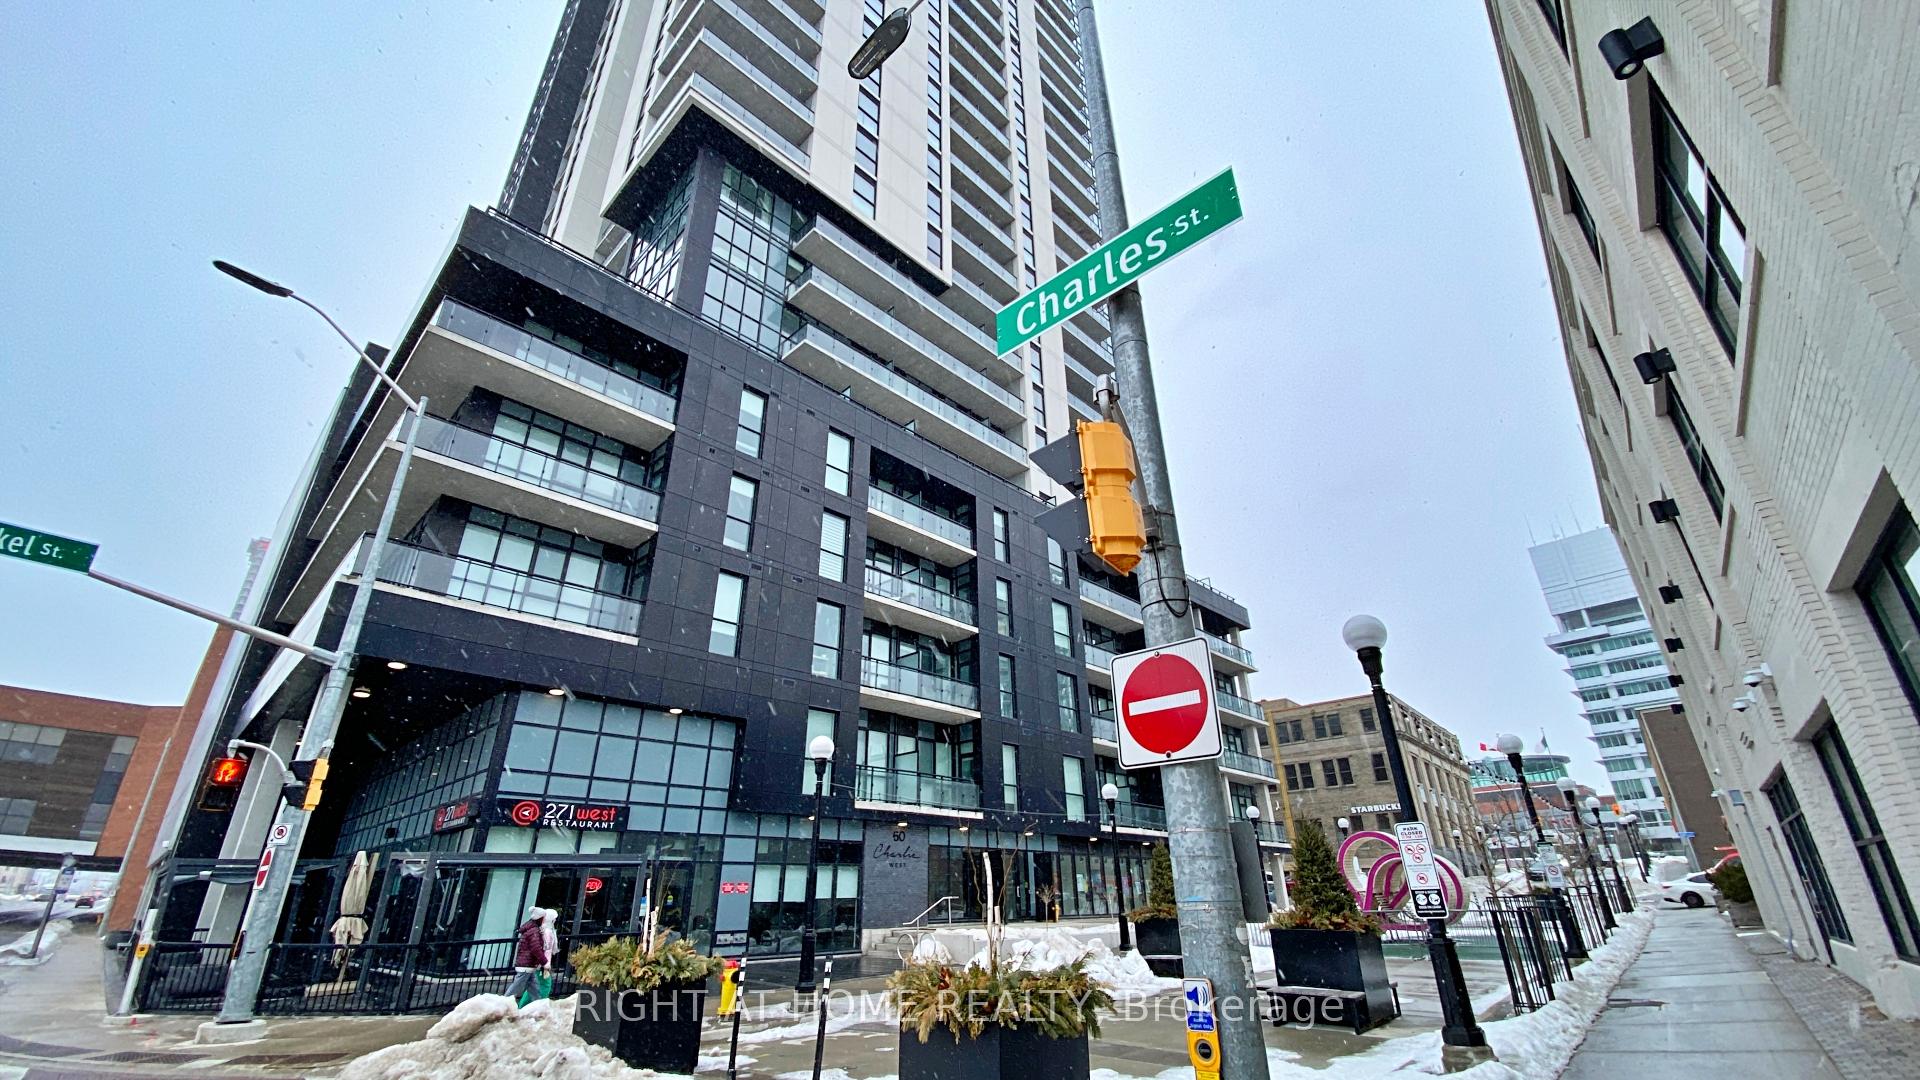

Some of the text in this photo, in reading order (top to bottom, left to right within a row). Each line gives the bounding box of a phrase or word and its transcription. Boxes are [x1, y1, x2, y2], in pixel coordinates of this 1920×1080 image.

[1016, 227, 1168, 335] Charles
[543, 819, 614, 829] RESTAURANT
[873, 843, 920, 858] Charlie
